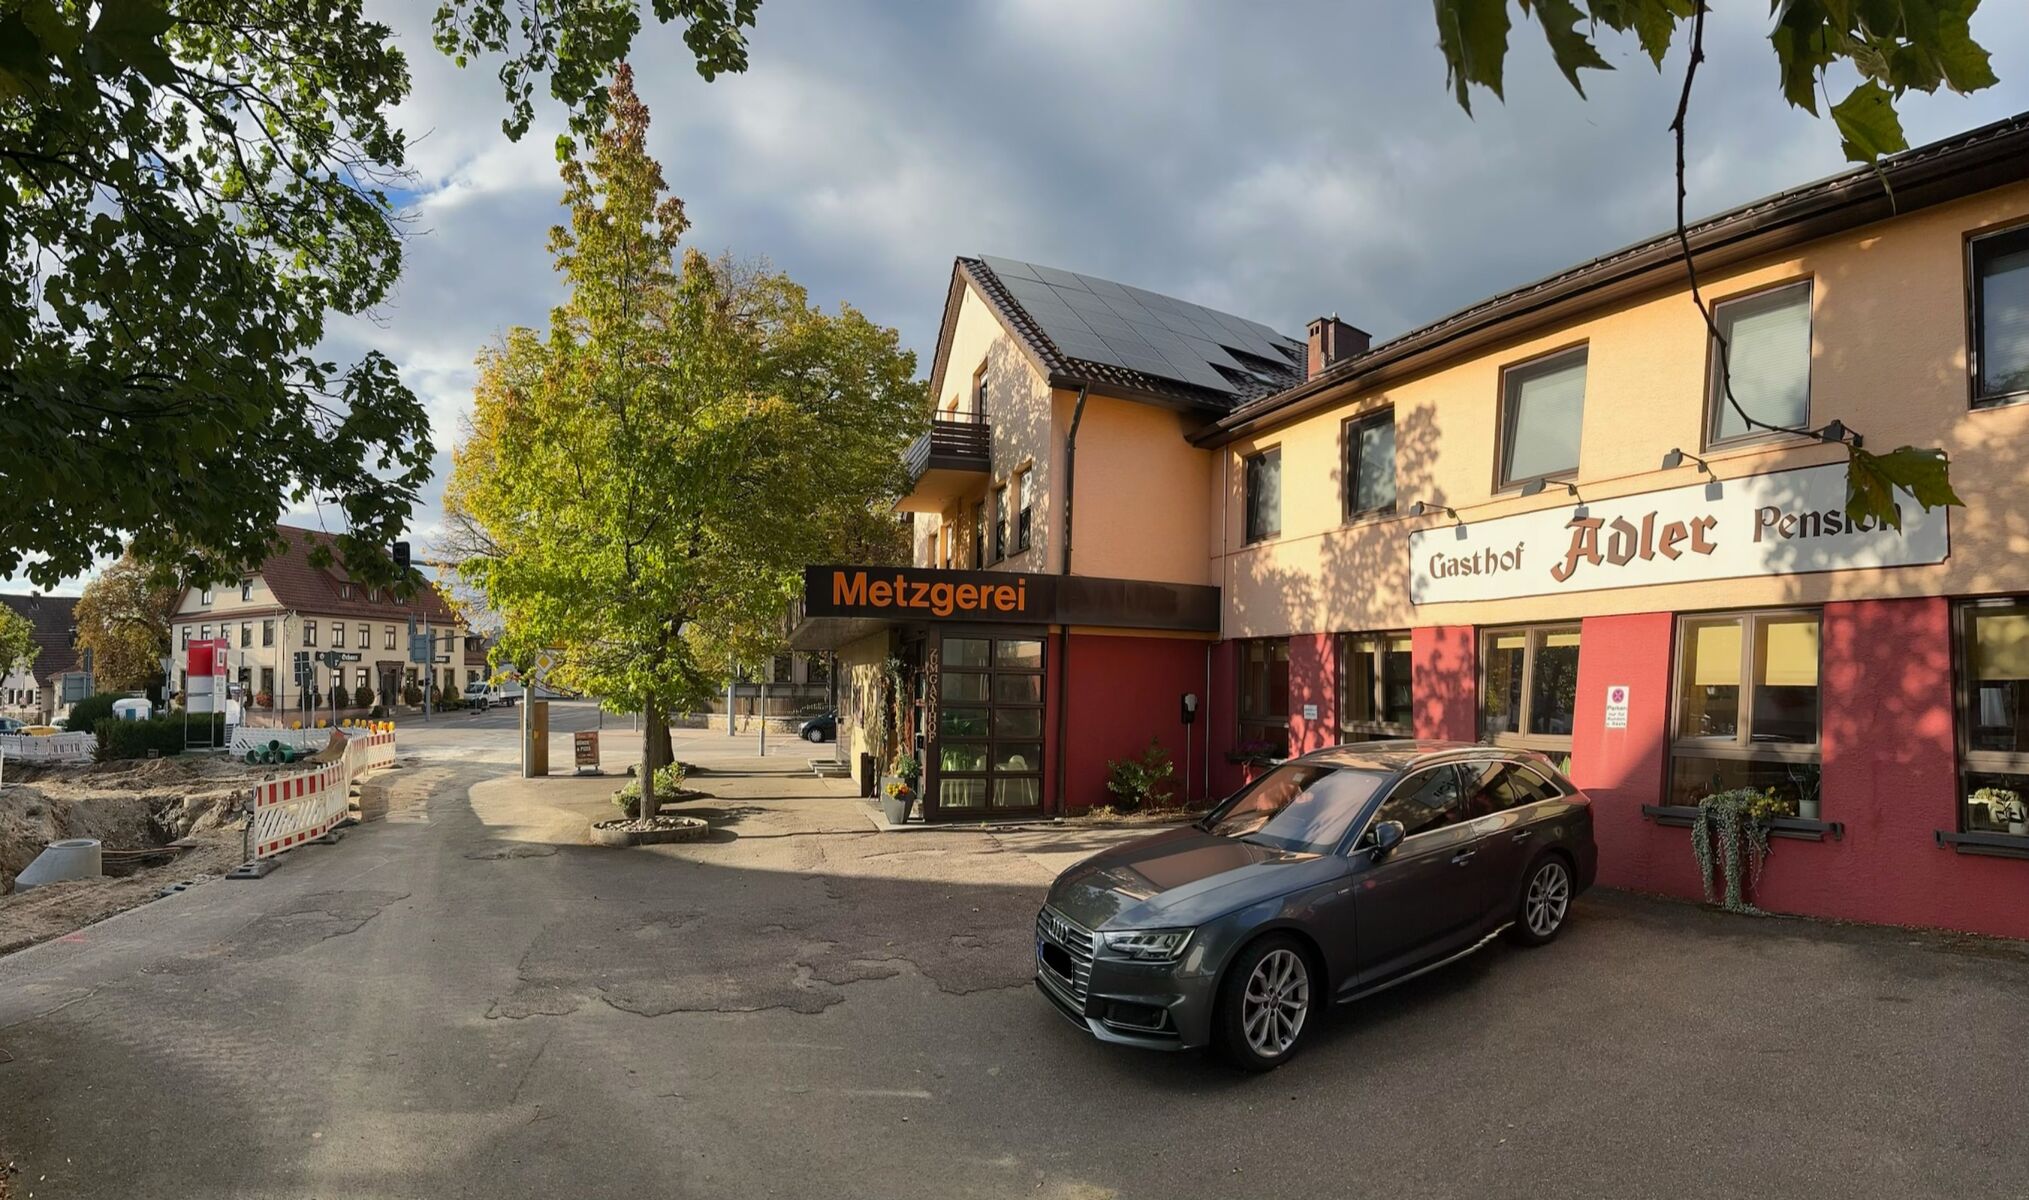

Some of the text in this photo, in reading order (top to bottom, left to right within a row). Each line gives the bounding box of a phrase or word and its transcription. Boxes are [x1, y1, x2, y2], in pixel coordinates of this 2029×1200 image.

[1429, 541, 1525, 580] Gasthof
[1549, 510, 1719, 584] Adler
[832, 570, 1026, 617] Metzgerei
[928, 648, 938, 743] ZUM GASTHOF
